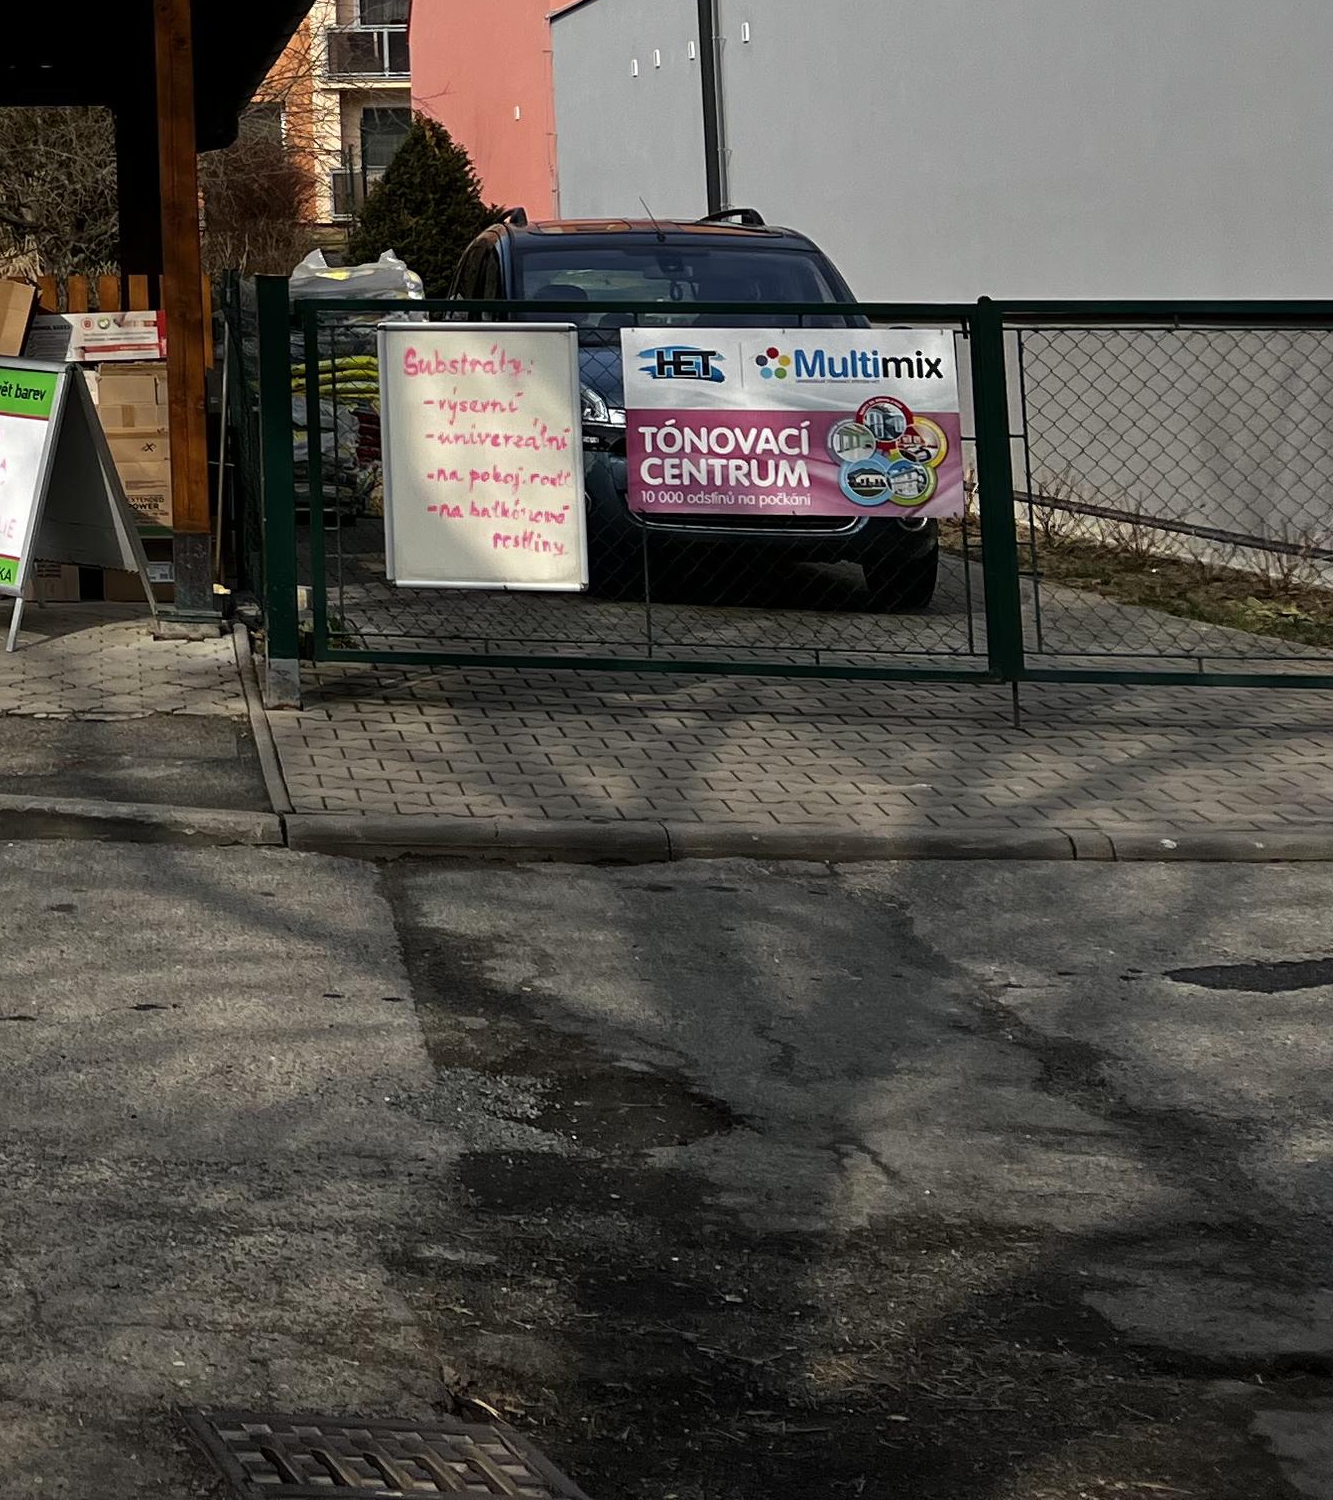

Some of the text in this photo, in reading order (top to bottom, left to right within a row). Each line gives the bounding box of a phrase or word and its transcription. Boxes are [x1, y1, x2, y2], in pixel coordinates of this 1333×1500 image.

[656, 349, 944, 380] HET Multimix
[15, 383, 47, 402] barev
[637, 418, 811, 455] TÓNOVACÍ
[639, 457, 811, 488] CENTRUM
[641, 490, 811, 508] 10 000 odstínů na počkání
